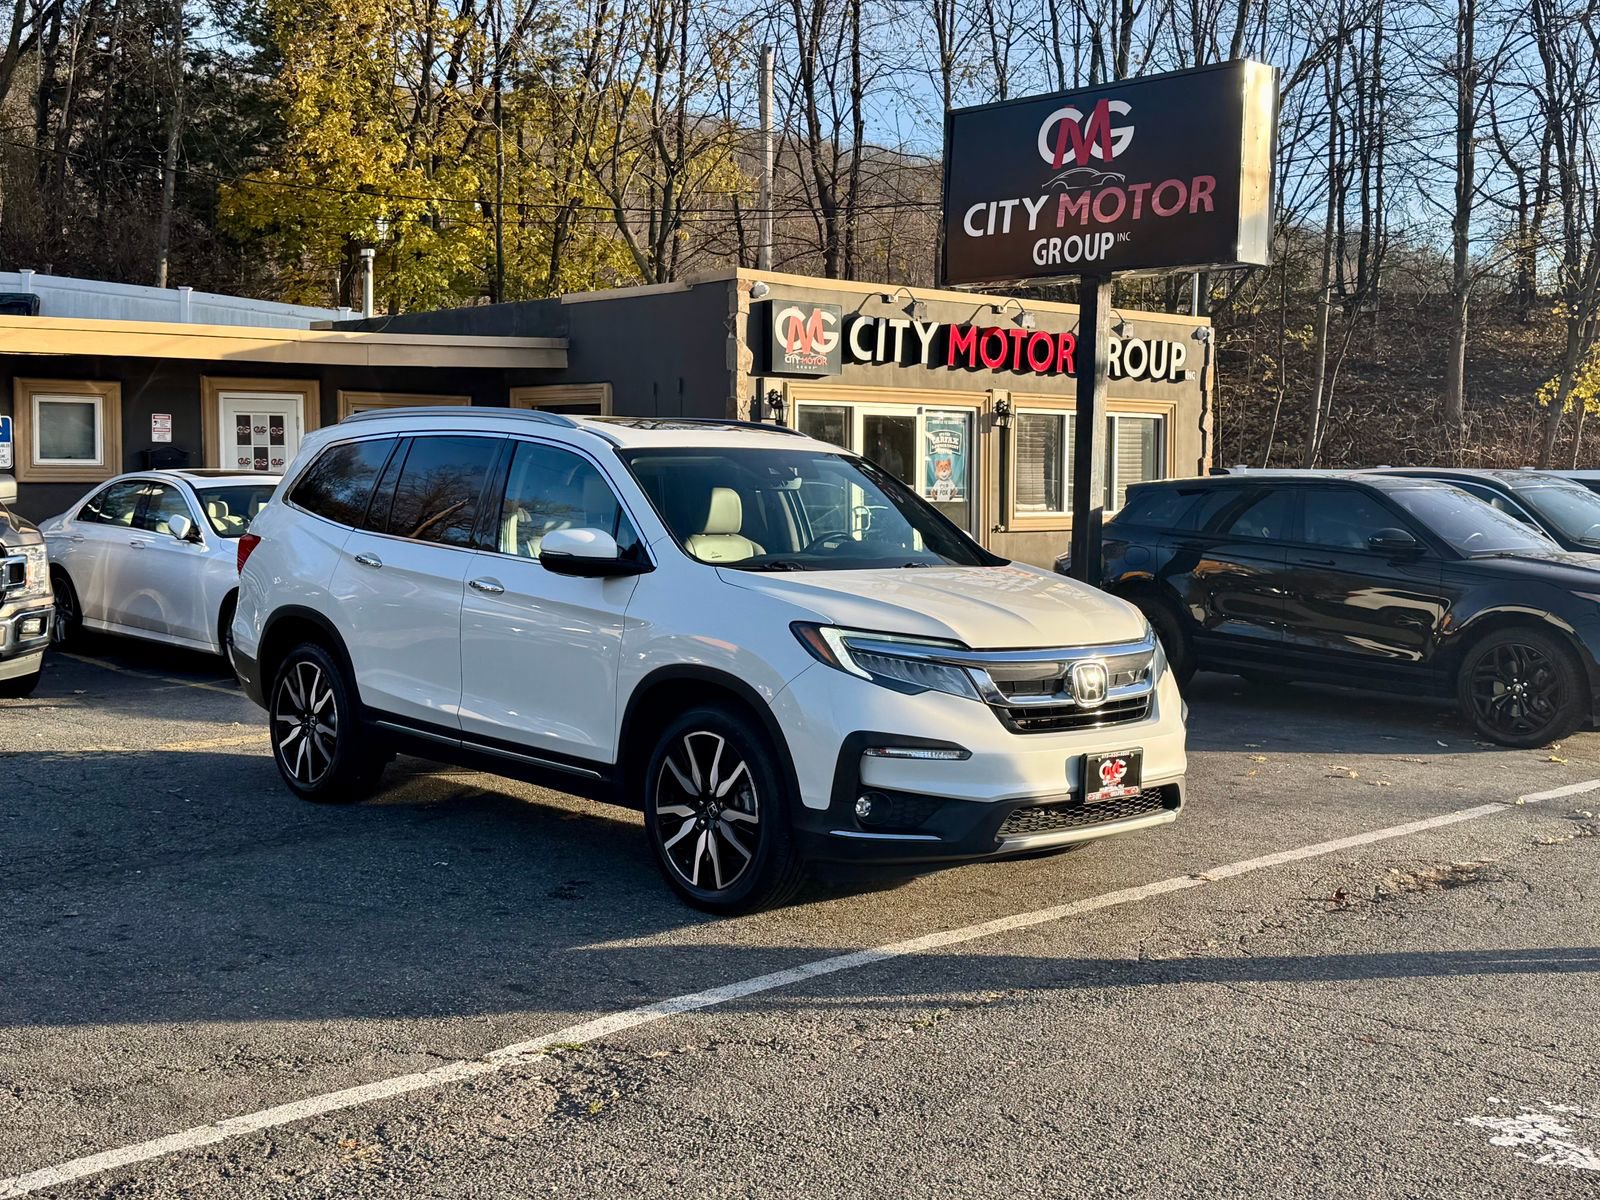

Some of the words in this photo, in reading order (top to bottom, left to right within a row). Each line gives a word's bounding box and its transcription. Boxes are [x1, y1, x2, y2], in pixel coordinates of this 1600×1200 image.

[963, 194, 1050, 238] CITY
[1056, 175, 1217, 228] MOTOR
[1032, 231, 1115, 266] GROUP
[1117, 231, 1131, 242] INC
[849, 315, 940, 364] CITY
[947, 323, 1076, 374] MOTOR
[1106, 336, 1187, 380] ROUP
